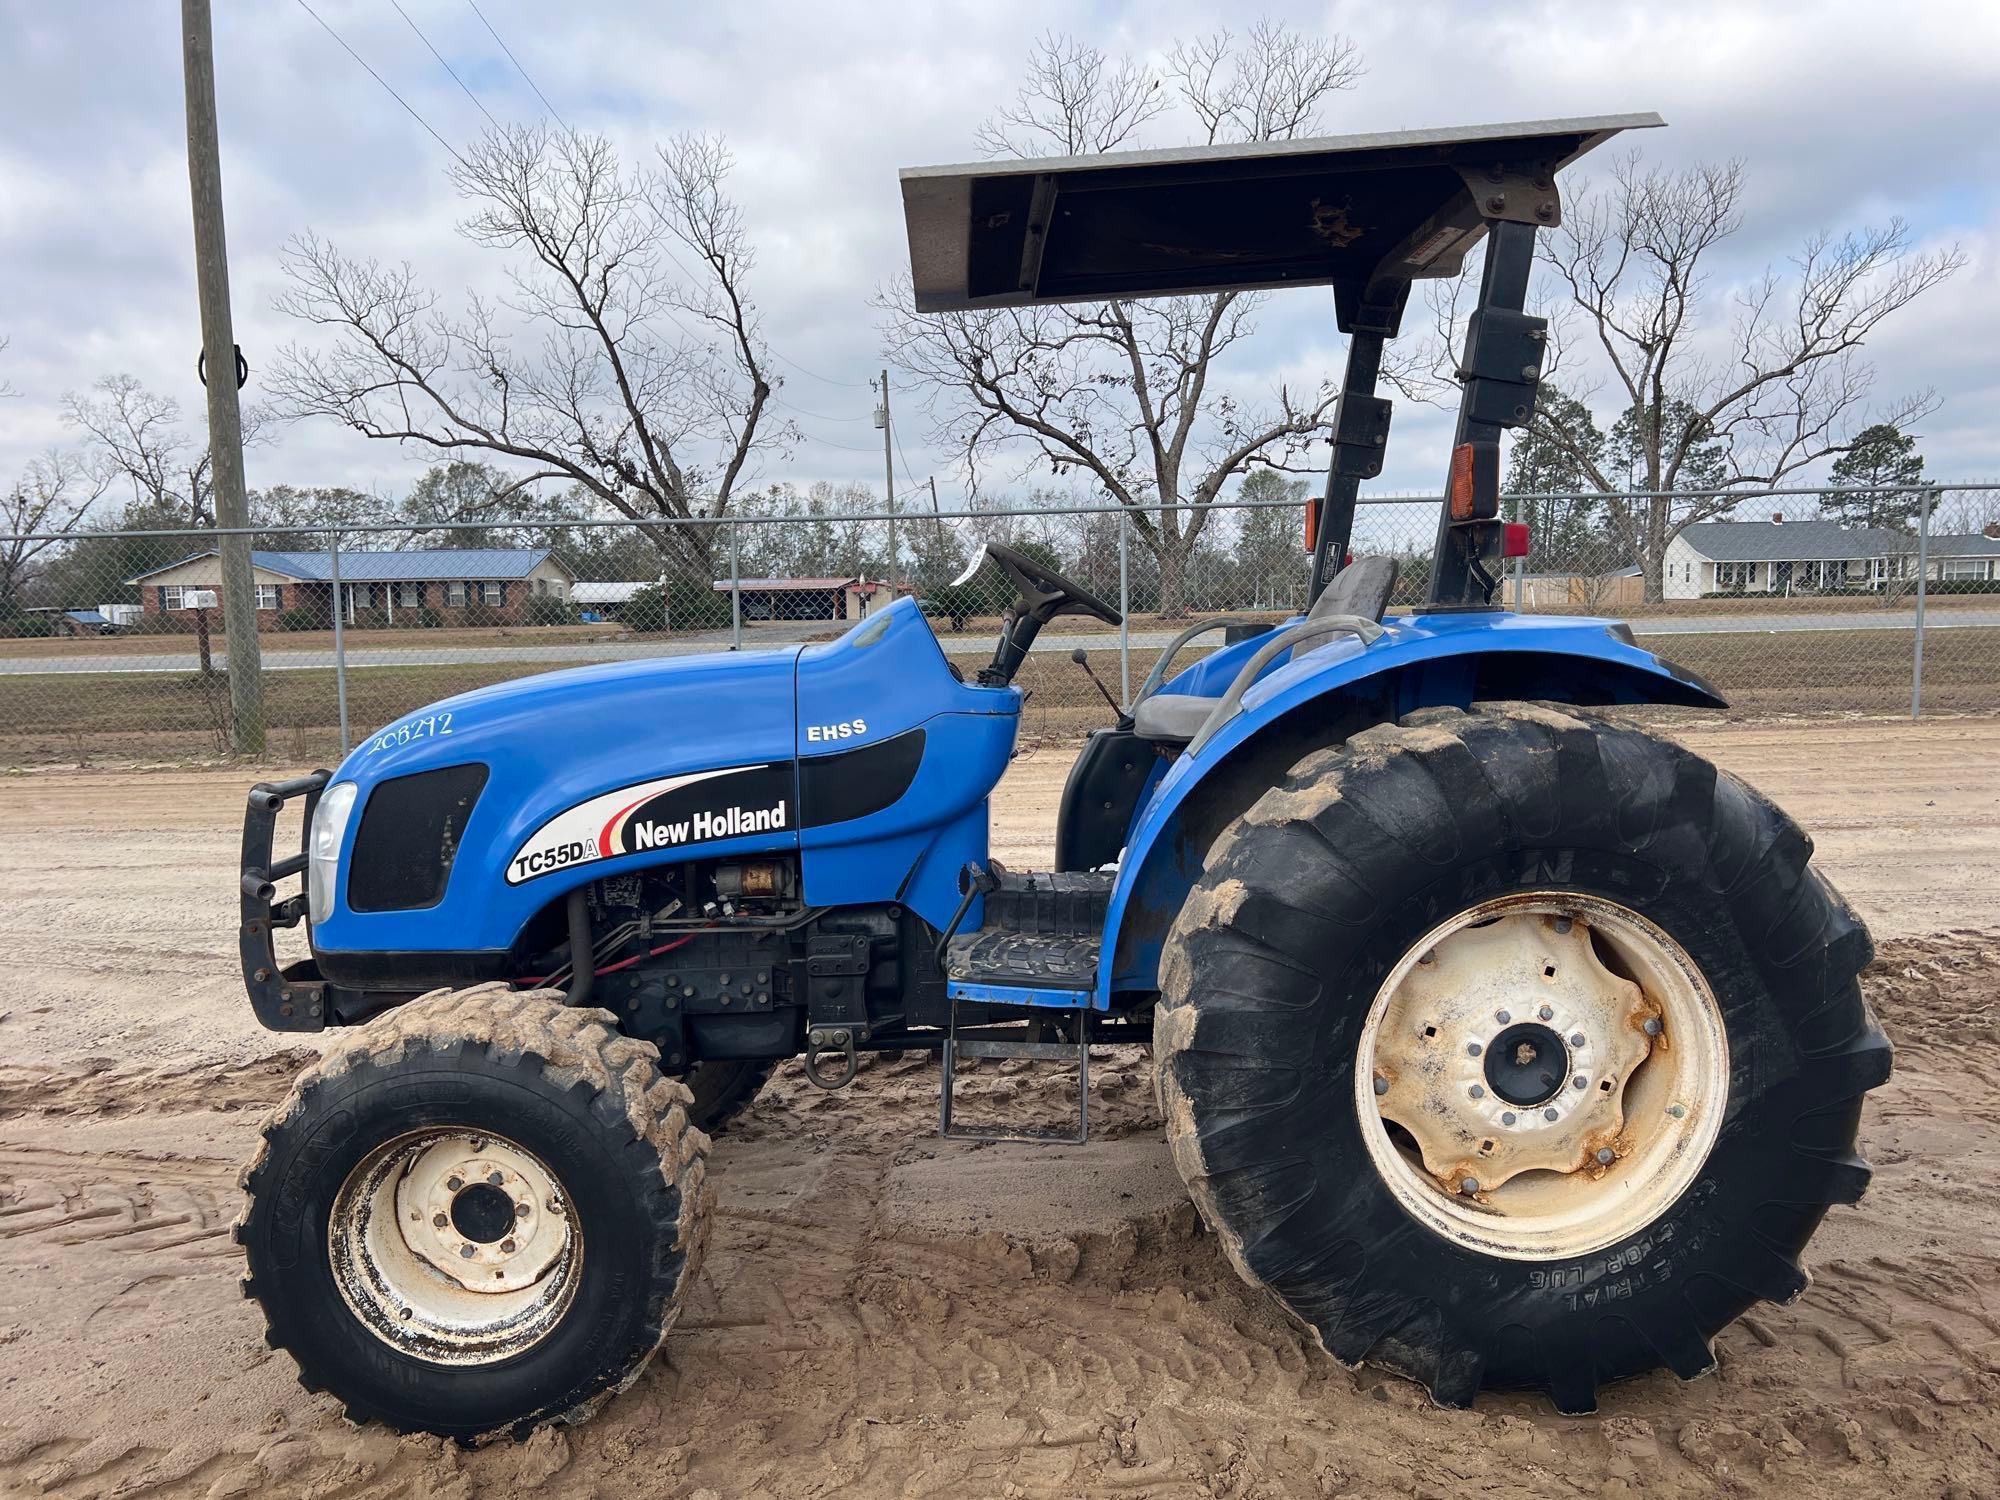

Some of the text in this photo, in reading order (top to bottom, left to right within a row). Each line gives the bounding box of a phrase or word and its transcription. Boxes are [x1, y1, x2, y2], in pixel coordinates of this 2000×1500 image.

[807, 718, 867, 742] EHSS
[635, 800, 786, 850] New Holland
[516, 838, 599, 877] TC55DA
